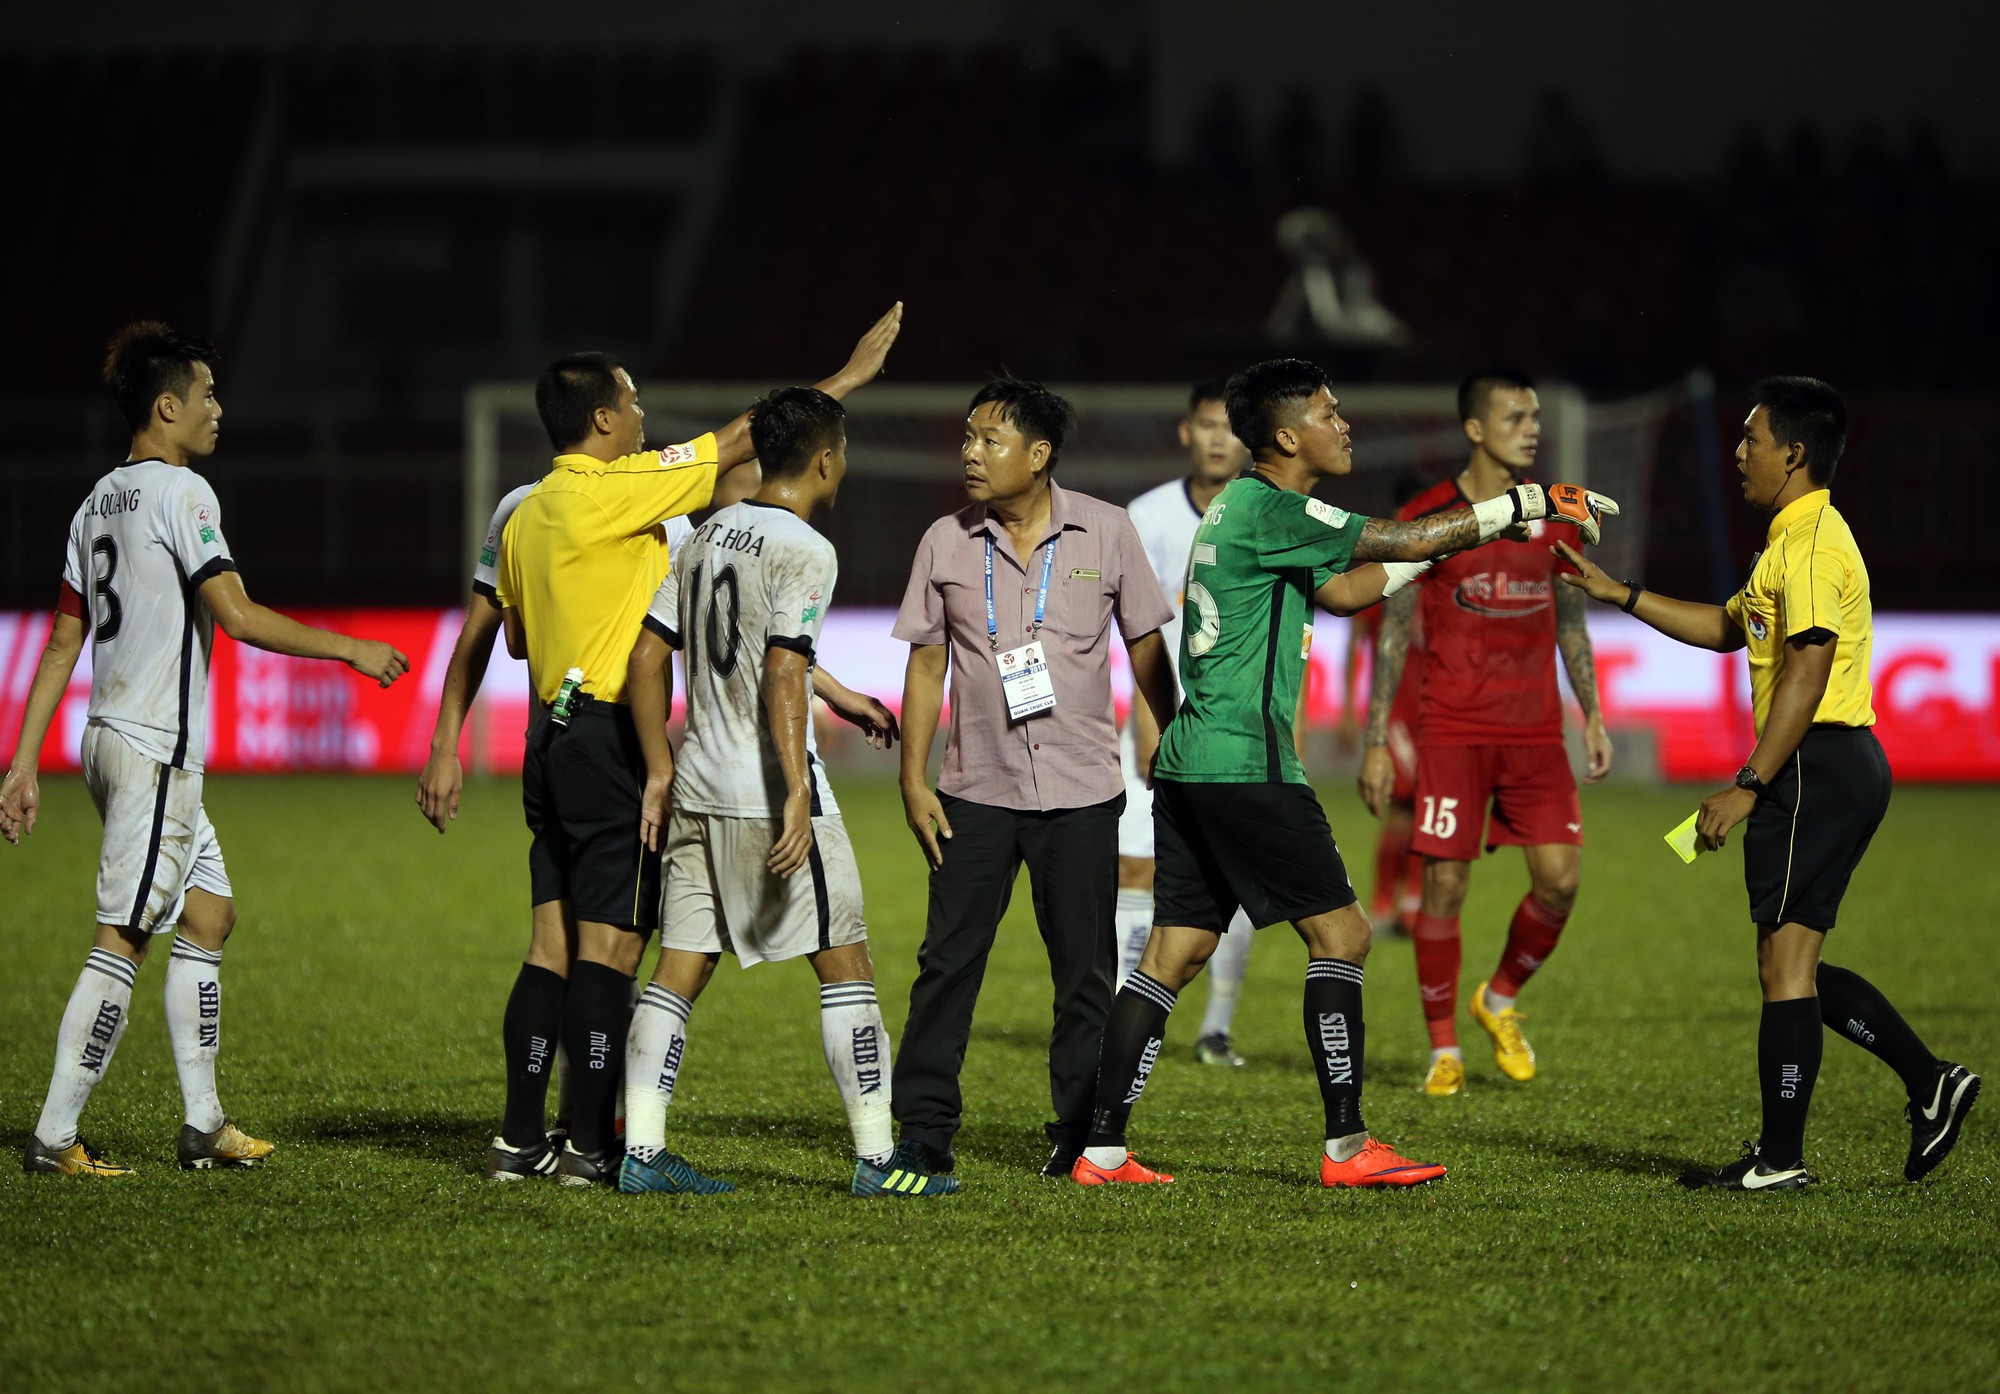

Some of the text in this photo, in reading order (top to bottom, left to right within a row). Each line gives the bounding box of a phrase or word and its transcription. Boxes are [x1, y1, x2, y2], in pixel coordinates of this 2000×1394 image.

[690, 559, 740, 679] 10
[1187, 543, 1220, 657] 5
[1419, 795, 1459, 839] 15
[198, 981, 219, 1020] SHB
[91, 1000, 122, 1044] SHB
[1846, 1018, 1875, 1045] mitre
[527, 1036, 548, 1074] mitre
[589, 1031, 611, 1070] mitre
[664, 1034, 684, 1073] SHB
[852, 1026, 879, 1065] SHB
[1781, 1064, 1802, 1099] mitre
